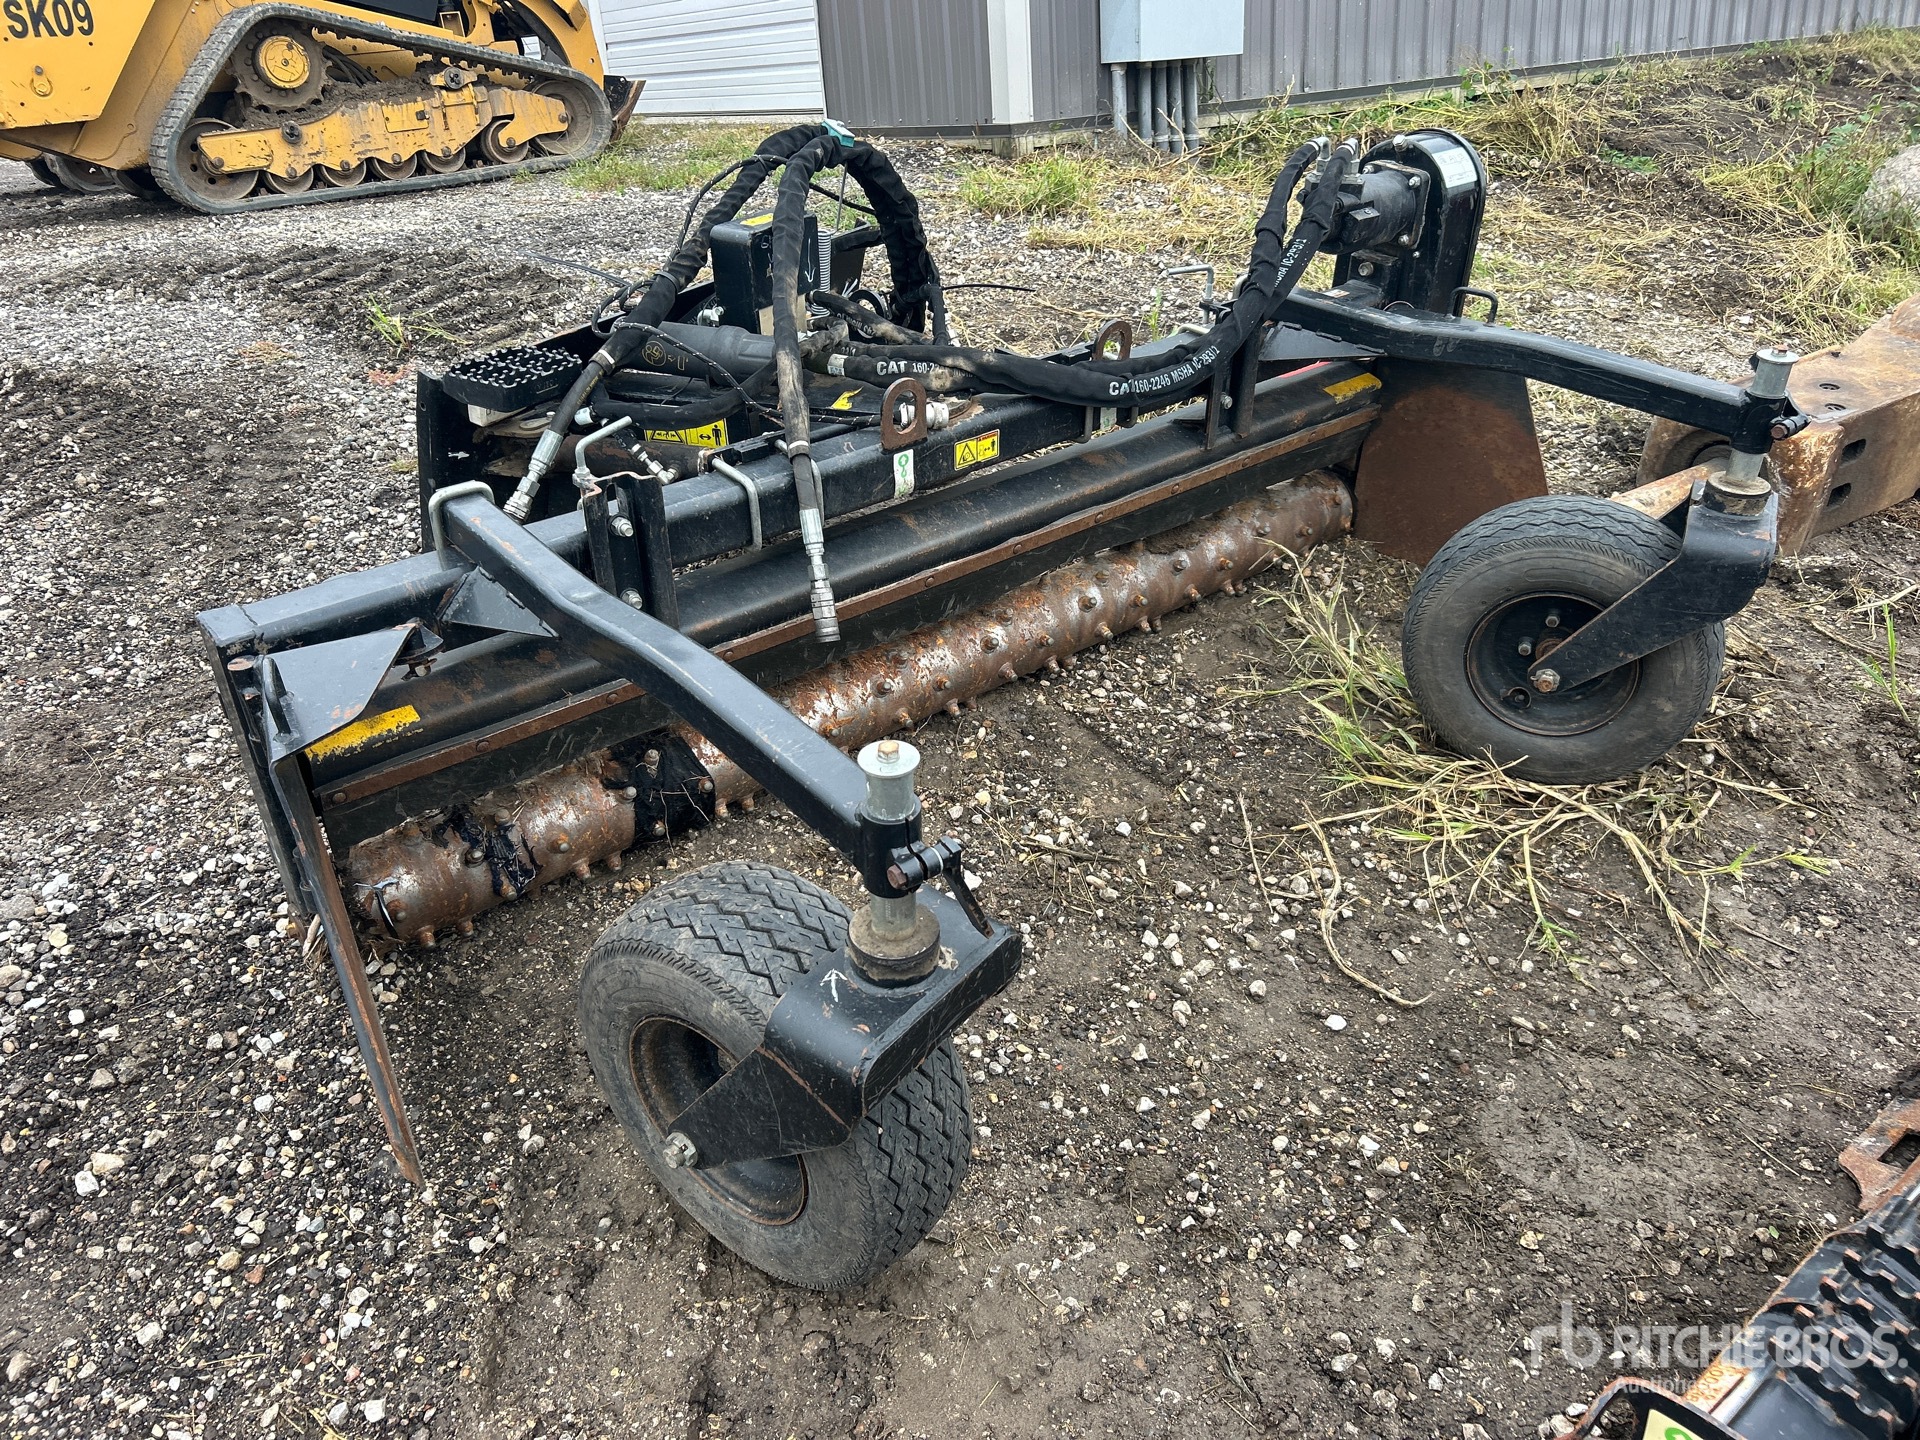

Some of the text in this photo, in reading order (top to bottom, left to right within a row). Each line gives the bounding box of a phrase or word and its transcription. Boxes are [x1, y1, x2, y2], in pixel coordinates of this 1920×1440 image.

[3, 0, 94, 39] SK09
[876, 360, 908, 376] CAT
[1134, 373, 1171, 394] 160-2246
[1171, 363, 1195, 383] MSHA
